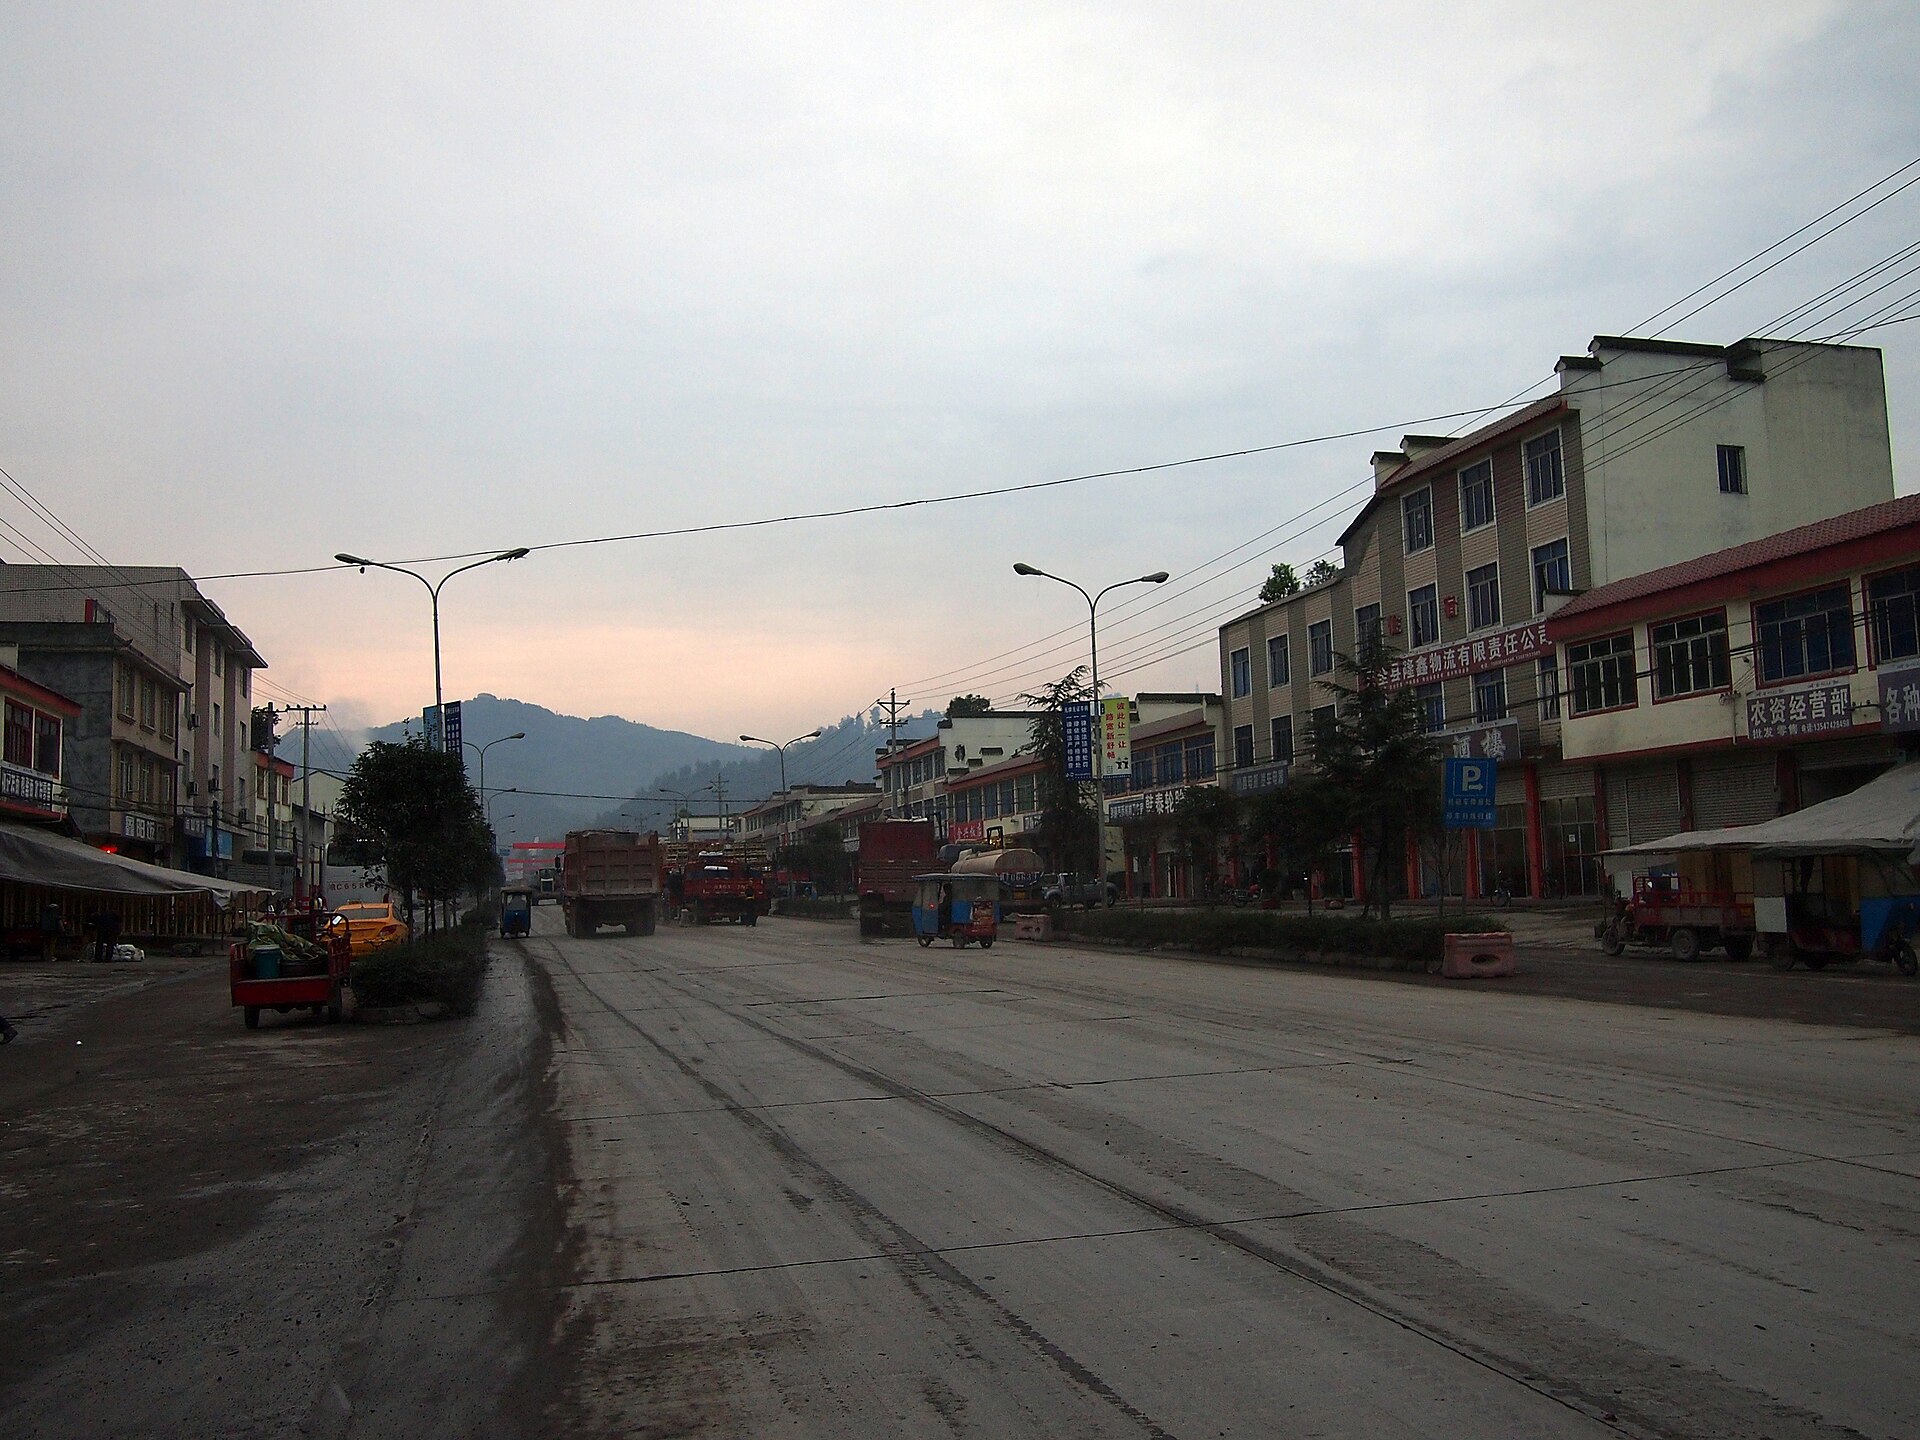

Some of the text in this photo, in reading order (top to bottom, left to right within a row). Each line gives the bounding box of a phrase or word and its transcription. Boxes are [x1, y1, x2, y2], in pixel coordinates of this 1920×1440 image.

[1751, 687, 1848, 726] 农资经营部
[1753, 727, 1773, 739] 批发
